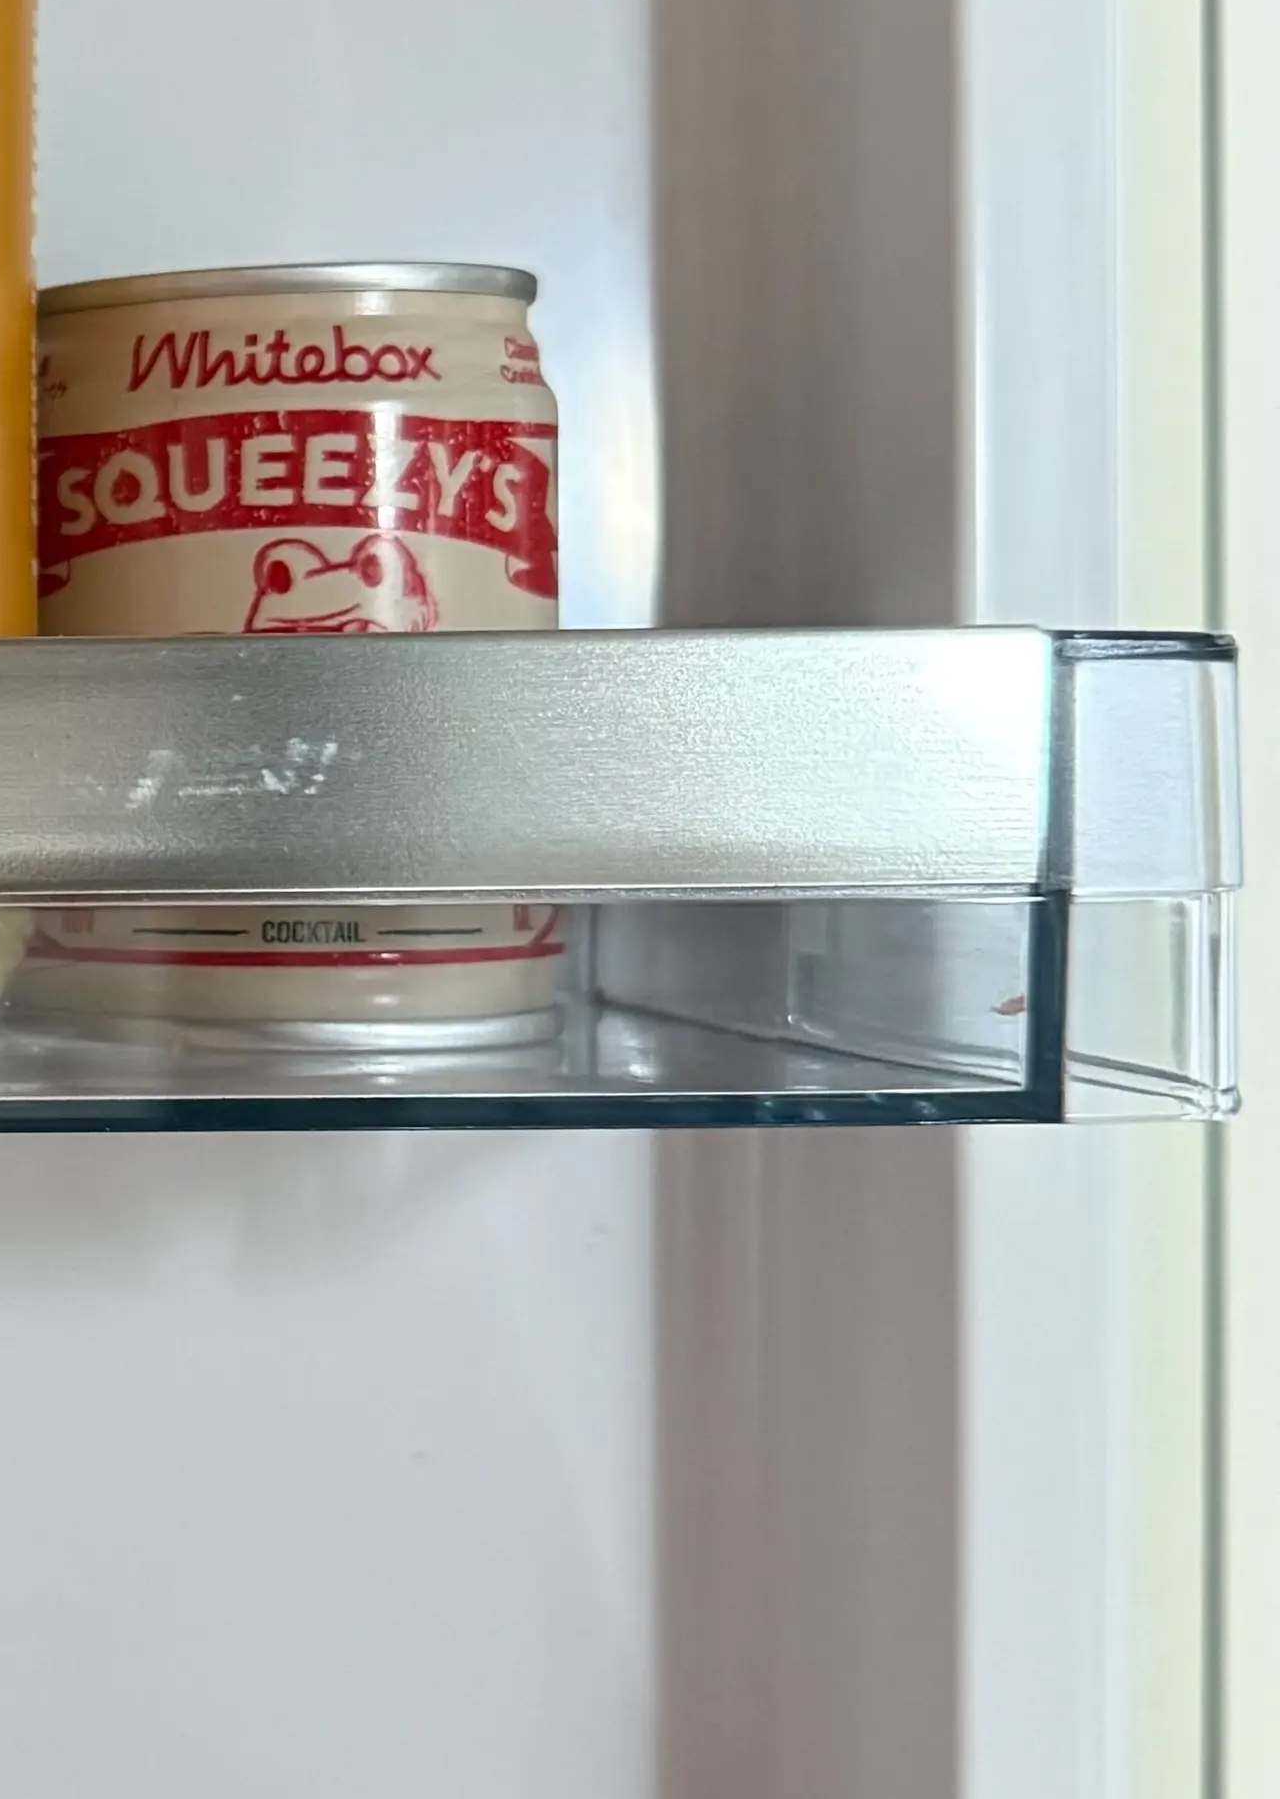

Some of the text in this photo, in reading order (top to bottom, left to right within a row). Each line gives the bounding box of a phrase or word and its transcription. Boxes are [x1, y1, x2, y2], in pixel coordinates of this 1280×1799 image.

[128, 325, 442, 393] Whitebox
[56, 433, 525, 537] SQUEEZY'S
[261, 919, 367, 945] COCKTAIL
